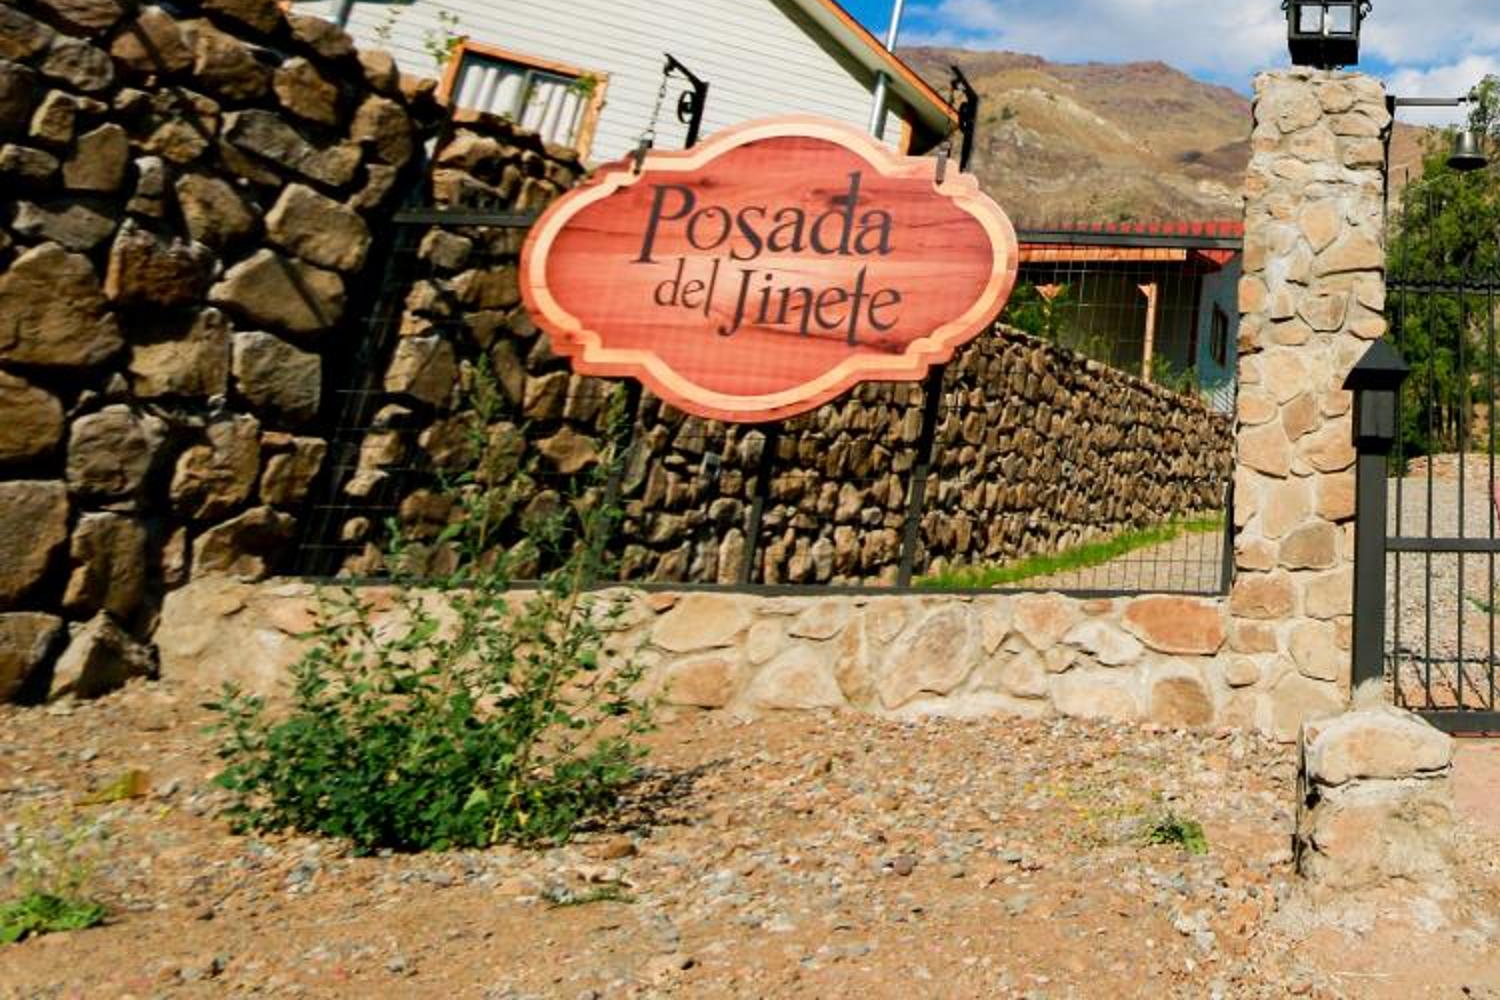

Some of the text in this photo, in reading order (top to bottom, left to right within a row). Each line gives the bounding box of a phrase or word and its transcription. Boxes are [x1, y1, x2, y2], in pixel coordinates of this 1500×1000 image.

[630, 170, 895, 264] Posada
[653, 258, 903, 346] del Jinete
